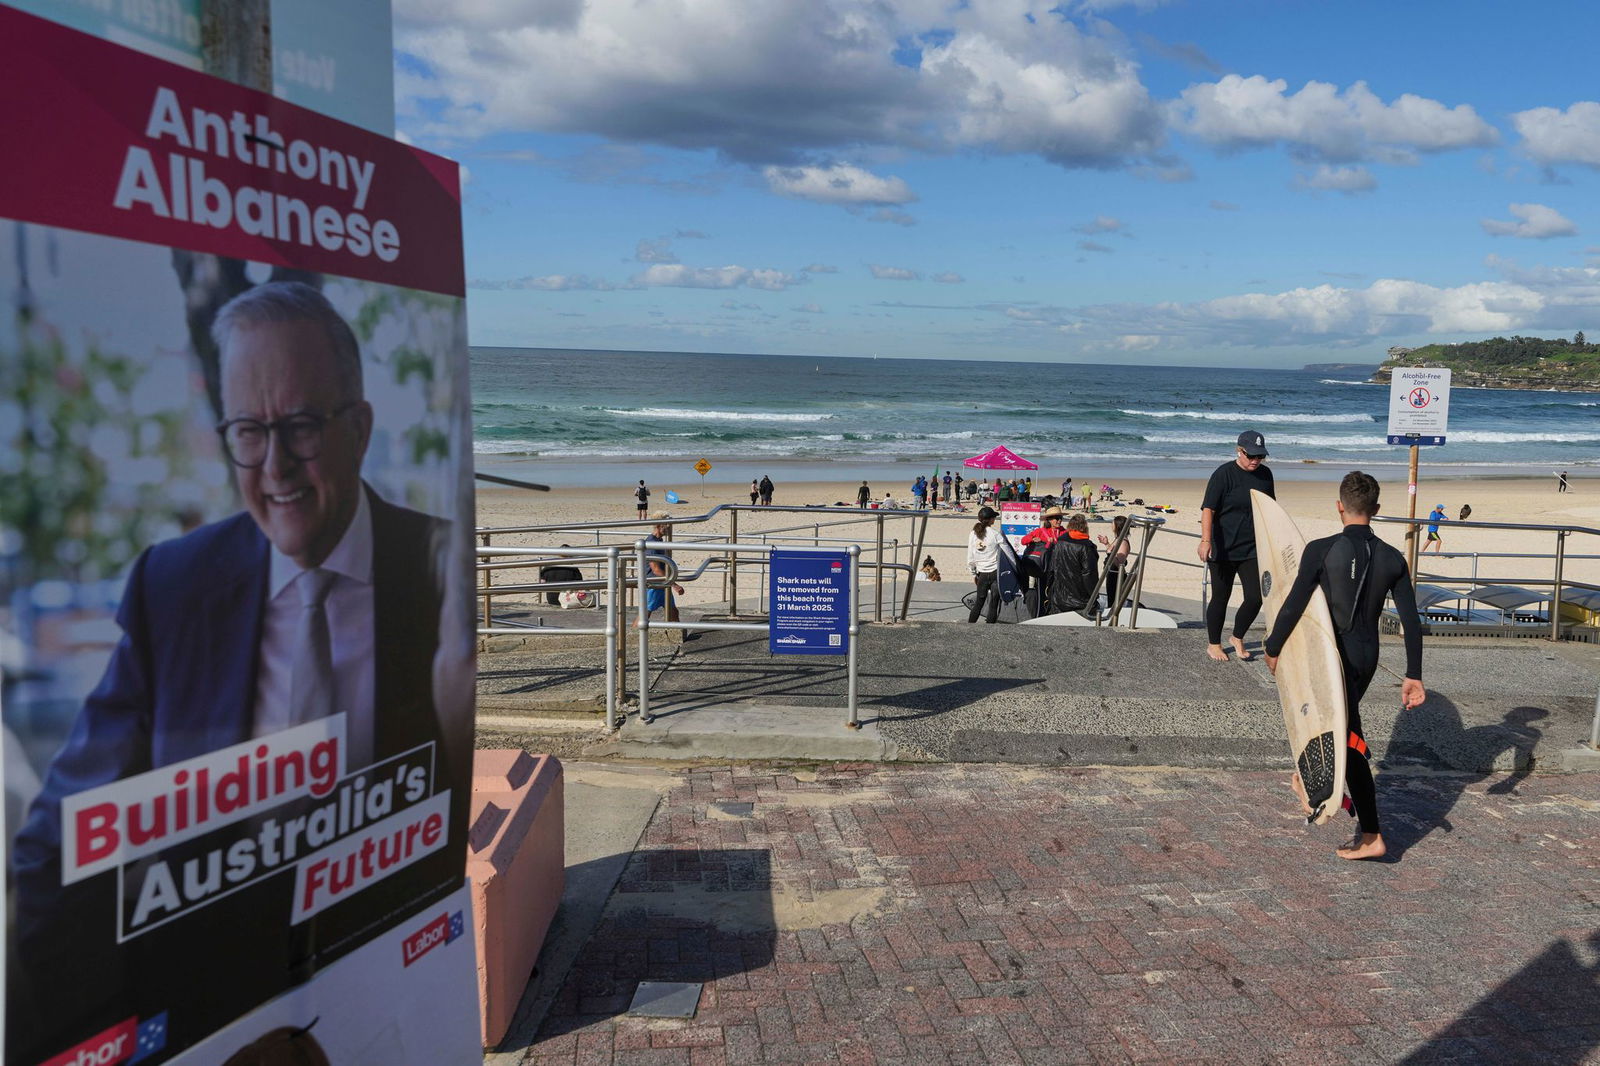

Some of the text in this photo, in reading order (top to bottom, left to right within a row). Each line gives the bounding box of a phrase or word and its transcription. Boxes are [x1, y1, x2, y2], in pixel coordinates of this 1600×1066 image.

[145, 86, 375, 209] Anthony
[112, 145, 400, 262] Albanese
[777, 576, 800, 584] Shark
[818, 577, 832, 585] will
[777, 585, 786, 593] be
[777, 594, 791, 602] this
[777, 603, 786, 611] 31
[75, 737, 338, 868] Building
[131, 764, 426, 927] Australia's
[303, 812, 442, 912] Future
[406, 923, 446, 960] Labor
[64, 1032, 128, 1066] bor
